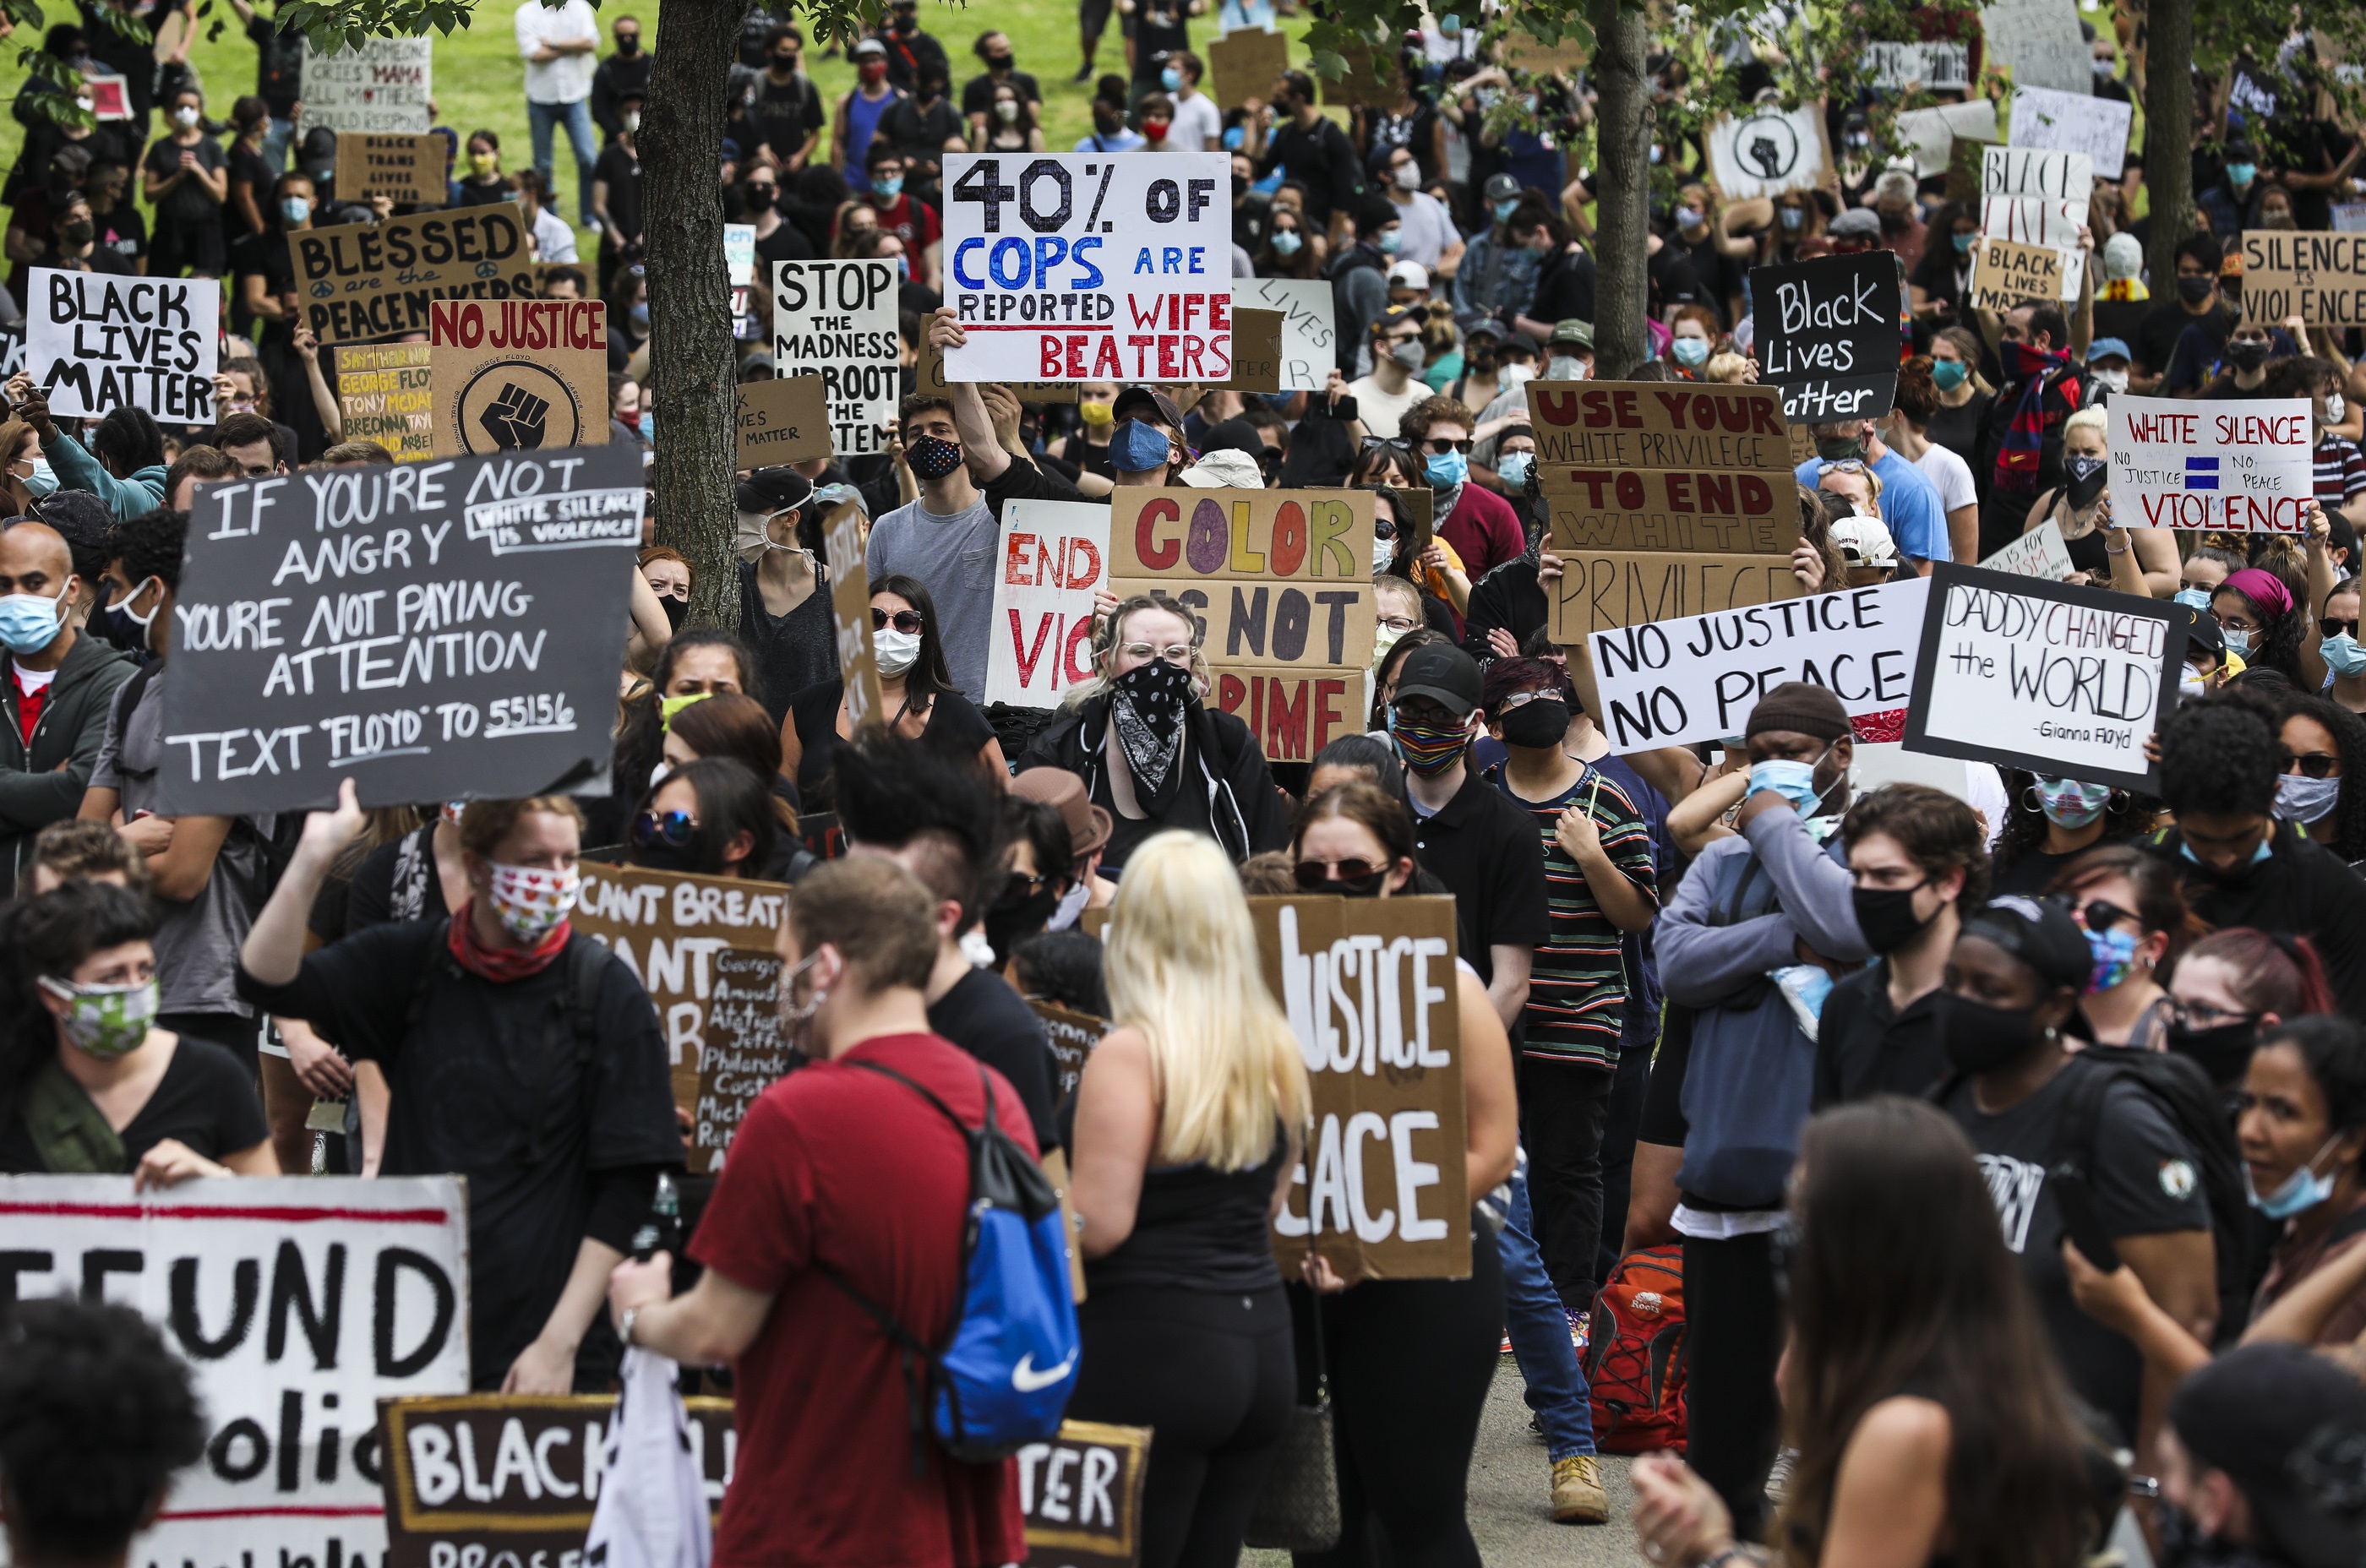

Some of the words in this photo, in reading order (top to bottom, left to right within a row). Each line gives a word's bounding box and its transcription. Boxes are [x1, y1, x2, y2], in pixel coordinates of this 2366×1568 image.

[366, 136, 416, 148] BLACK
[367, 154, 415, 166] TRANS
[369, 172, 412, 183] LIVES
[952, 159, 1115, 233] 40%
[1145, 178, 1216, 223] OF
[299, 214, 519, 280] BLESSED
[953, 237, 1104, 290] COPS
[1133, 246, 1206, 275] ARE
[1989, 247, 2057, 277] BLACK
[2246, 237, 2366, 275] SILENCE
[345, 277, 381, 293] are
[395, 267, 441, 286] the
[777, 263, 891, 312] STOP
[2003, 271, 2049, 295] LIVES
[2293, 270, 2315, 286] IS
[50, 274, 190, 329] BLACK
[958, 293, 1115, 321] REPORTED
[1127, 293, 1231, 331] WIFE
[1259, 278, 1334, 348] LIVES
[1776, 273, 1885, 334] Black
[1978, 286, 2028, 310] MAT
[2244, 288, 2366, 324] VIOLENCE
[432, 301, 484, 348] NO
[489, 301, 607, 350] JUSTICE
[810, 316, 852, 330] THE
[74, 324, 201, 372] LIVES
[341, 351, 367, 369] SAY
[367, 349, 407, 369] THEIR
[777, 331, 898, 359] MADNESS
[1040, 335, 1231, 378] BEATERS
[1767, 340, 1854, 374] Lives
[339, 370, 398, 394] GEORGE
[470, 356, 501, 377] GEORGE
[548, 362, 565, 378] ERIC
[566, 381, 584, 411] GARNER
[1235, 359, 1276, 378] TER
[42, 358, 214, 420] MATTER
[341, 394, 387, 415] TONY
[450, 390, 461, 419] TAYLOR
[1779, 380, 1874, 416] atter
[344, 413, 410, 436] BREONNA
[737, 411, 766, 428] VES
[1536, 389, 1644, 428] USE
[1654, 392, 1785, 436] YOUR
[2128, 412, 2199, 444] WHITE
[2216, 414, 2307, 445] SILENCE
[745, 426, 801, 447] MATTER
[1536, 431, 1631, 466] WHITE
[1640, 433, 1769, 468] PRIVILEGE
[2114, 451, 2130, 466] NO
[2125, 468, 2181, 485] JUSTICE
[2232, 455, 2254, 469] NO
[208, 478, 288, 542] IF
[465, 457, 586, 505] NOT
[1572, 471, 1646, 510] TO
[1665, 473, 1774, 515] END
[2243, 473, 2282, 490] PEACE
[473, 499, 551, 530] WHITE
[2141, 493, 2314, 532] VIOLENCE
[497, 525, 522, 547] IS
[531, 518, 635, 543] VIOLENCE
[1135, 498, 1355, 577] COLOR
[1557, 511, 1778, 553] WHITE
[272, 520, 453, 585] ANGRY
[1005, 532, 1100, 590] END
[301, 590, 386, 647] NOT
[396, 580, 535, 635] PAYING
[1227, 586, 1359, 665] NOT
[2046, 603, 2169, 659] CHANGED
[1596, 624, 1671, 678] NO
[1687, 590, 1884, 657] JUSTICE
[262, 629, 548, 697] ATTENTION
[1949, 641, 1996, 678] the
[1203, 672, 1349, 764] RIME
[1610, 685, 1687, 747] NO
[165, 723, 313, 782] TEXT
[435, 701, 480, 742] TO
[485, 691, 576, 729] 55156
[673, 882, 786, 928] BREAT
[1278, 904, 1451, 1076] JUSTICE
[0, 1238, 456, 1379] UND
[1632, 1298, 1660, 1314] Roots
[408, 1416, 615, 1506] BLACK
[1016, 1442, 1119, 1527] TER
